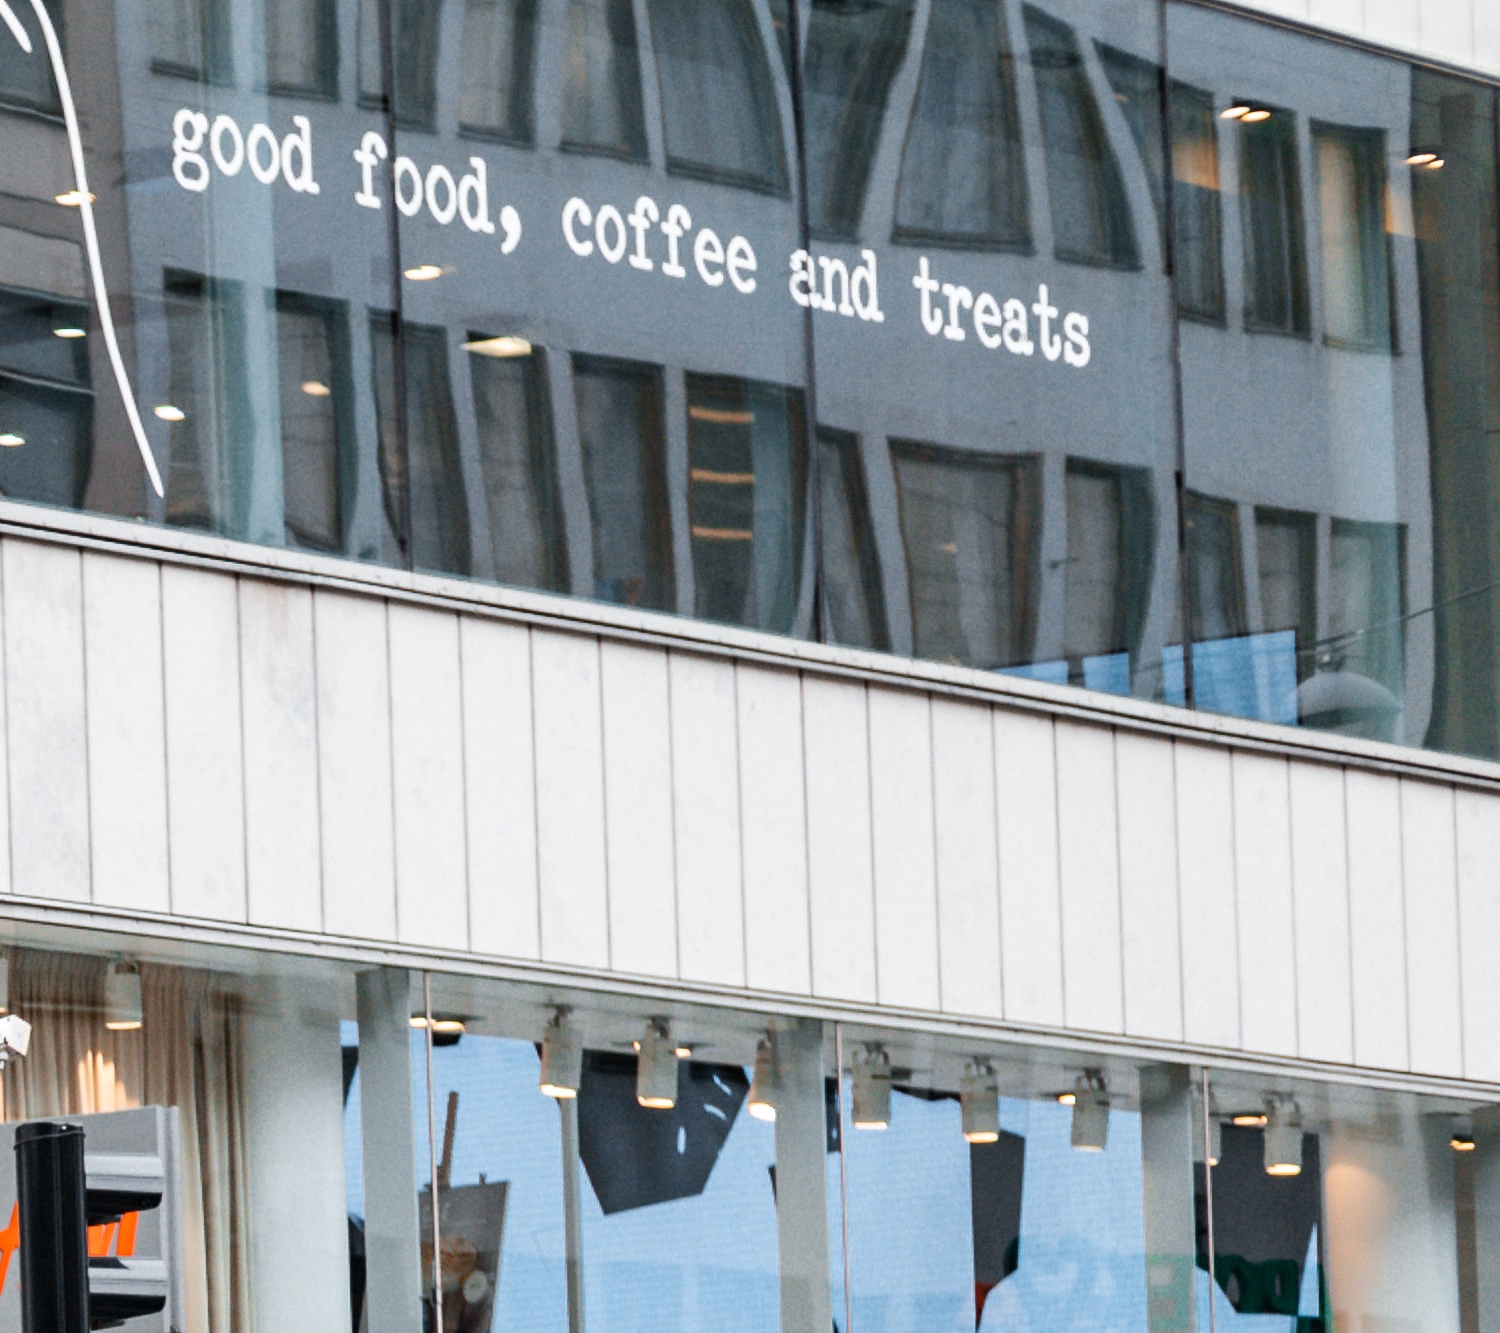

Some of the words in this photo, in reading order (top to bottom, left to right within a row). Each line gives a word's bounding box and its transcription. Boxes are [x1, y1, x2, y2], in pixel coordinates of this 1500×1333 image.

[173, 107, 321, 194] good
[353, 130, 522, 254] food,
[561, 195, 757, 294] coffee
[788, 249, 884, 322] and
[912, 256, 1091, 367] treats
